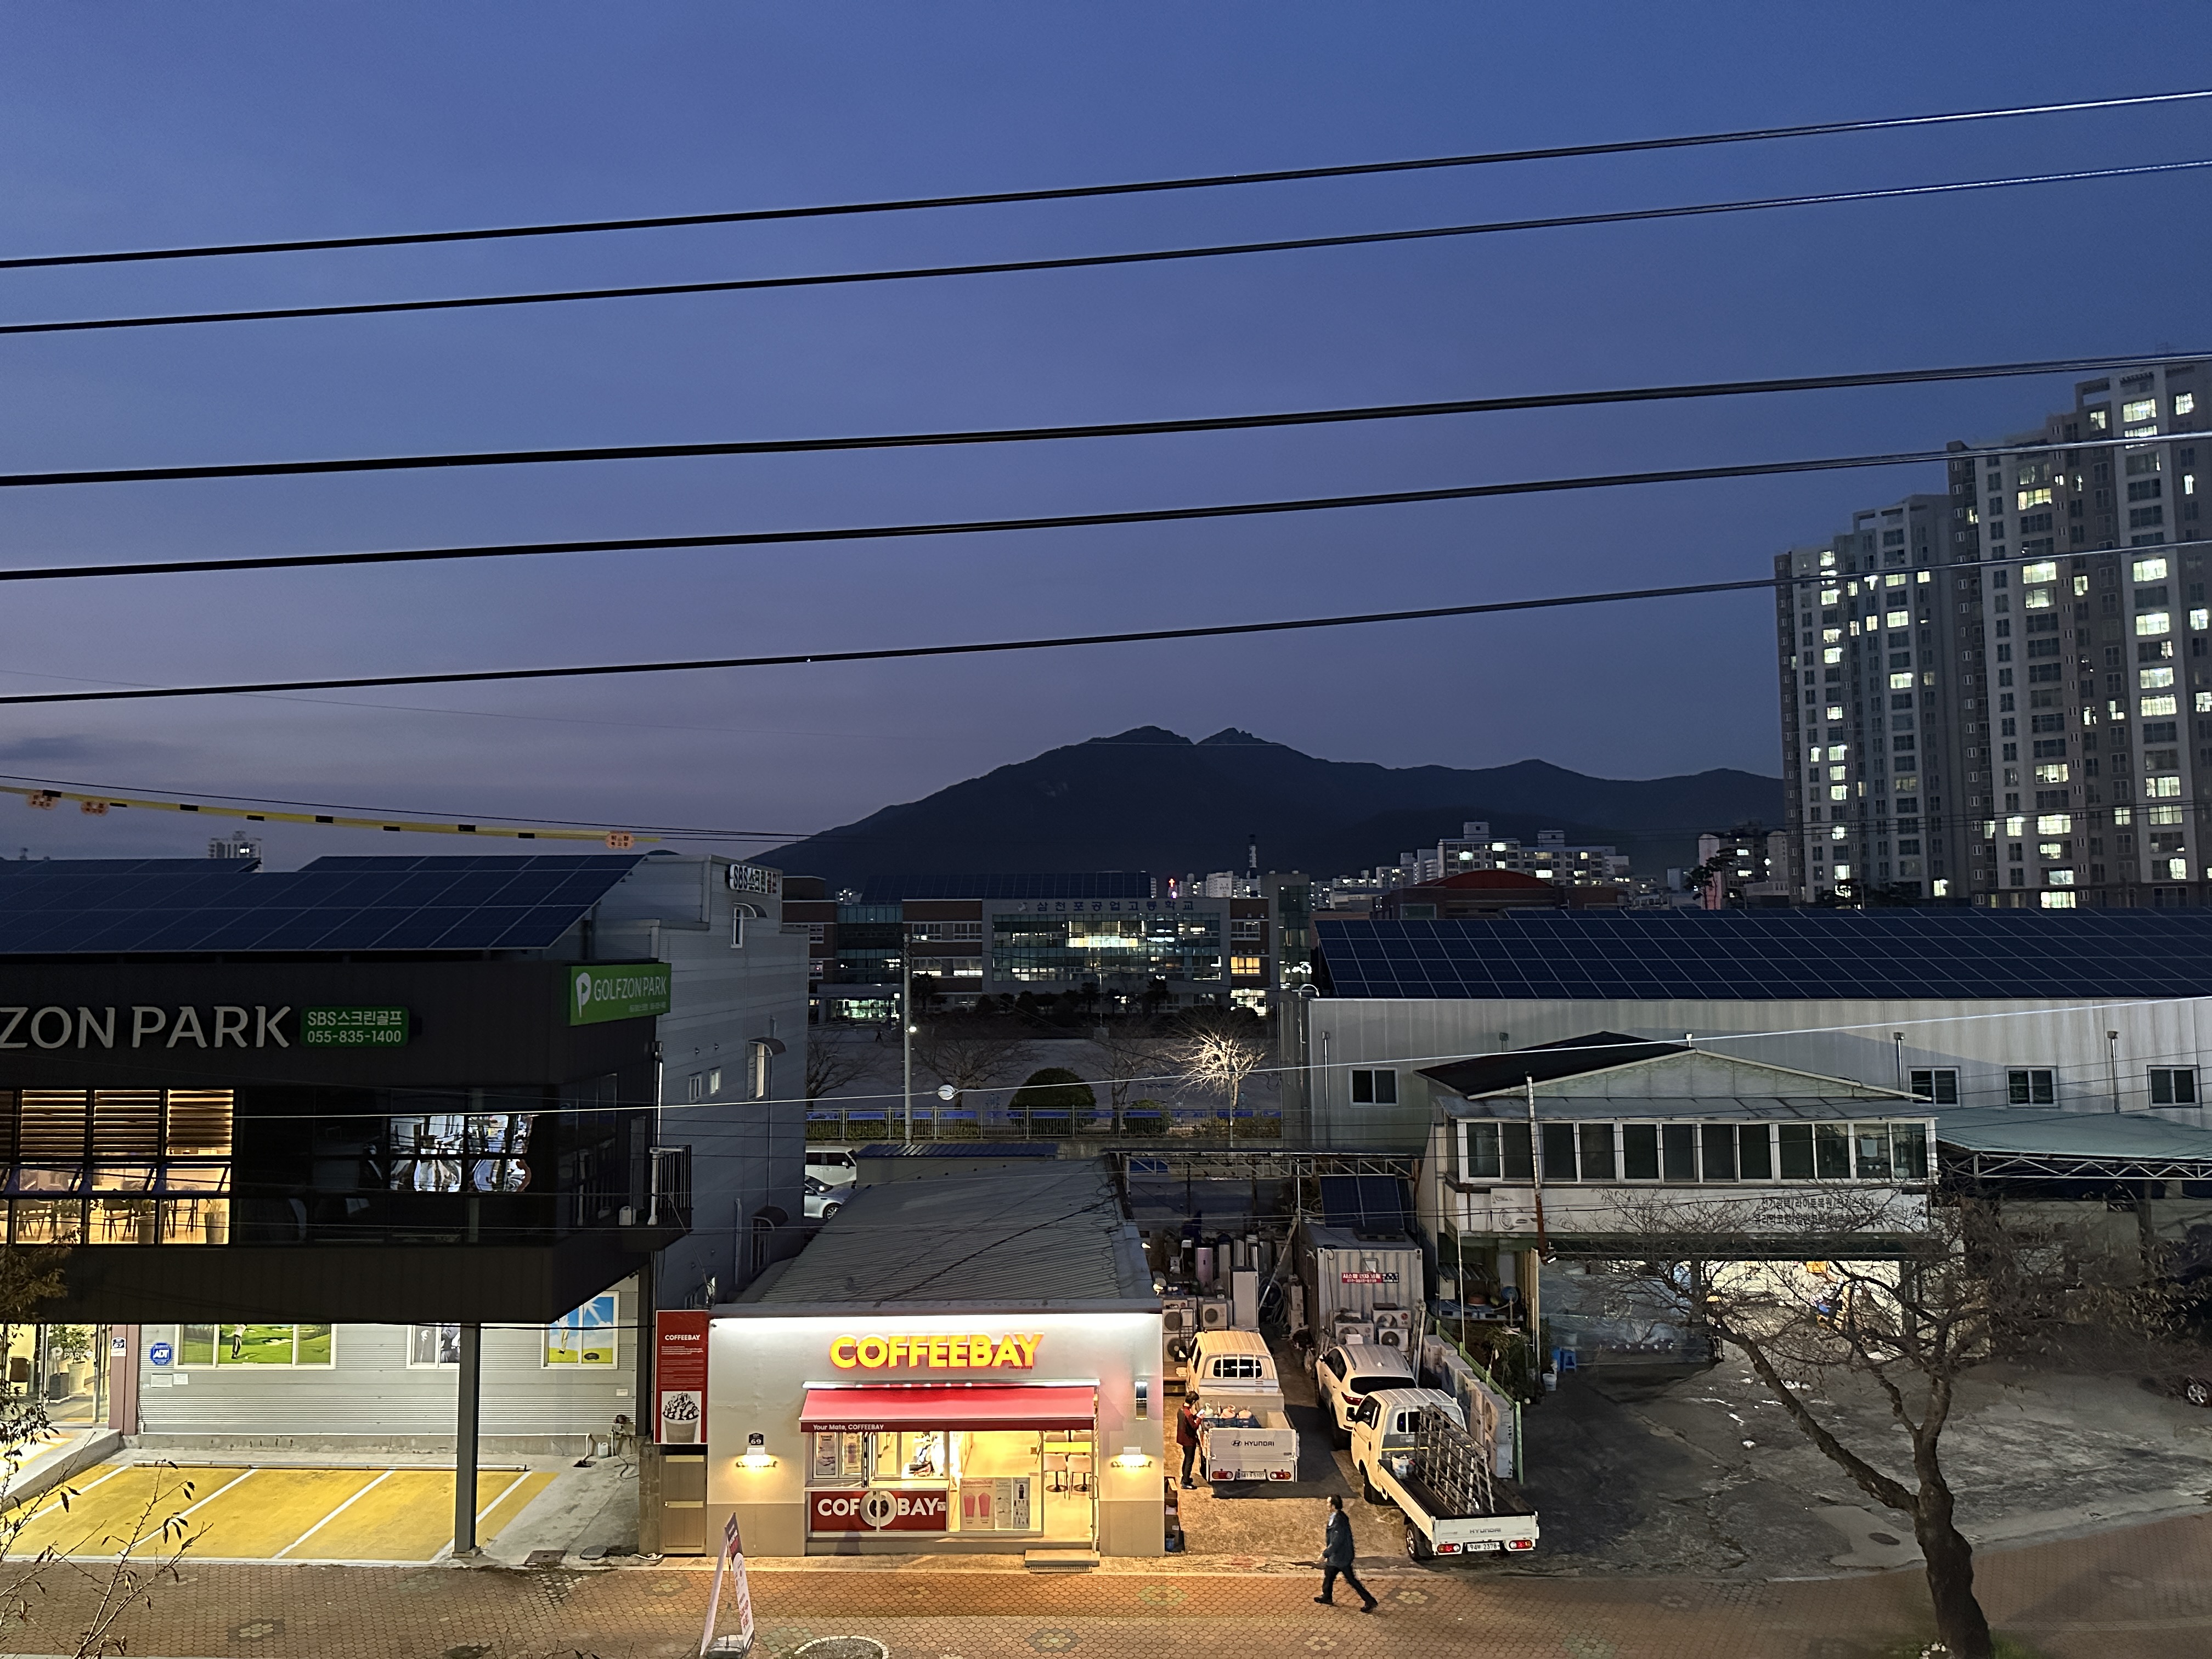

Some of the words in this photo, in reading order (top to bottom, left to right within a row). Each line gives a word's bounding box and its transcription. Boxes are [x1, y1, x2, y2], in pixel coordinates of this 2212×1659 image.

[594, 978, 642, 1002] GOLFZON
[643, 975, 667, 997] PARK
[0, 1006, 115, 1049] ZON
[132, 1005, 292, 1048] PARK
[307, 1010, 403, 1027] SBS스크린골프
[307, 1030, 402, 1043] 055-835-1400
[153, 1349, 170, 1358] ADT
[830, 1333, 1045, 1369] COFFEEBAY
